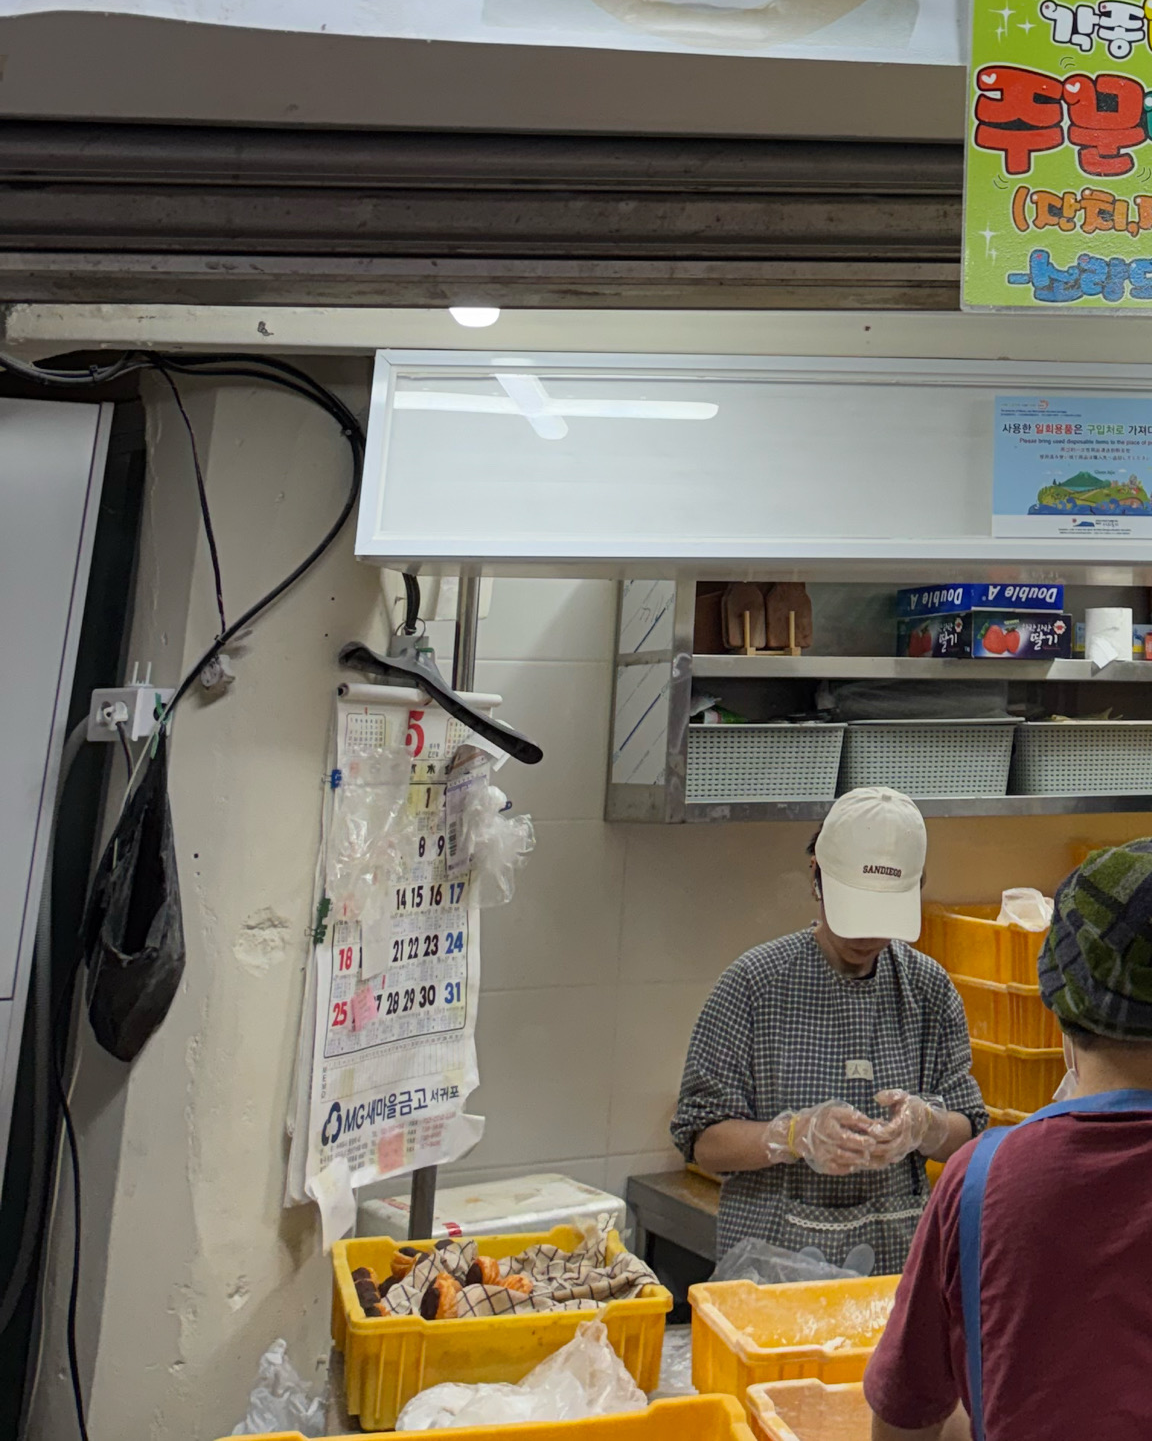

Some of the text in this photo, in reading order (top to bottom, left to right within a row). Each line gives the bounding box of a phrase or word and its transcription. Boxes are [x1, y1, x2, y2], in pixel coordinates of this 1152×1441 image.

[1002, 423, 1031, 435] 사용한
[1035, 423, 1083, 435] 일회용품은
[1087, 424, 1125, 436] 구입처로
[922, 588, 963, 608] Double
[1004, 586, 1058, 603] Double
[418, 835, 445, 857] 8 9
[396, 882, 465, 910] 14 15 16 17
[339, 931, 463, 971] 18 21 22 23 24
[332, 1001, 347, 1026] 25
[386, 991, 399, 1015] 28
[402, 988, 415, 1012] 29
[419, 985, 436, 1008] 30
[444, 982, 461, 1004] 31
[343, 1088, 428, 1134] MG새마을금고
[430, 1085, 459, 1104] 서귀포
